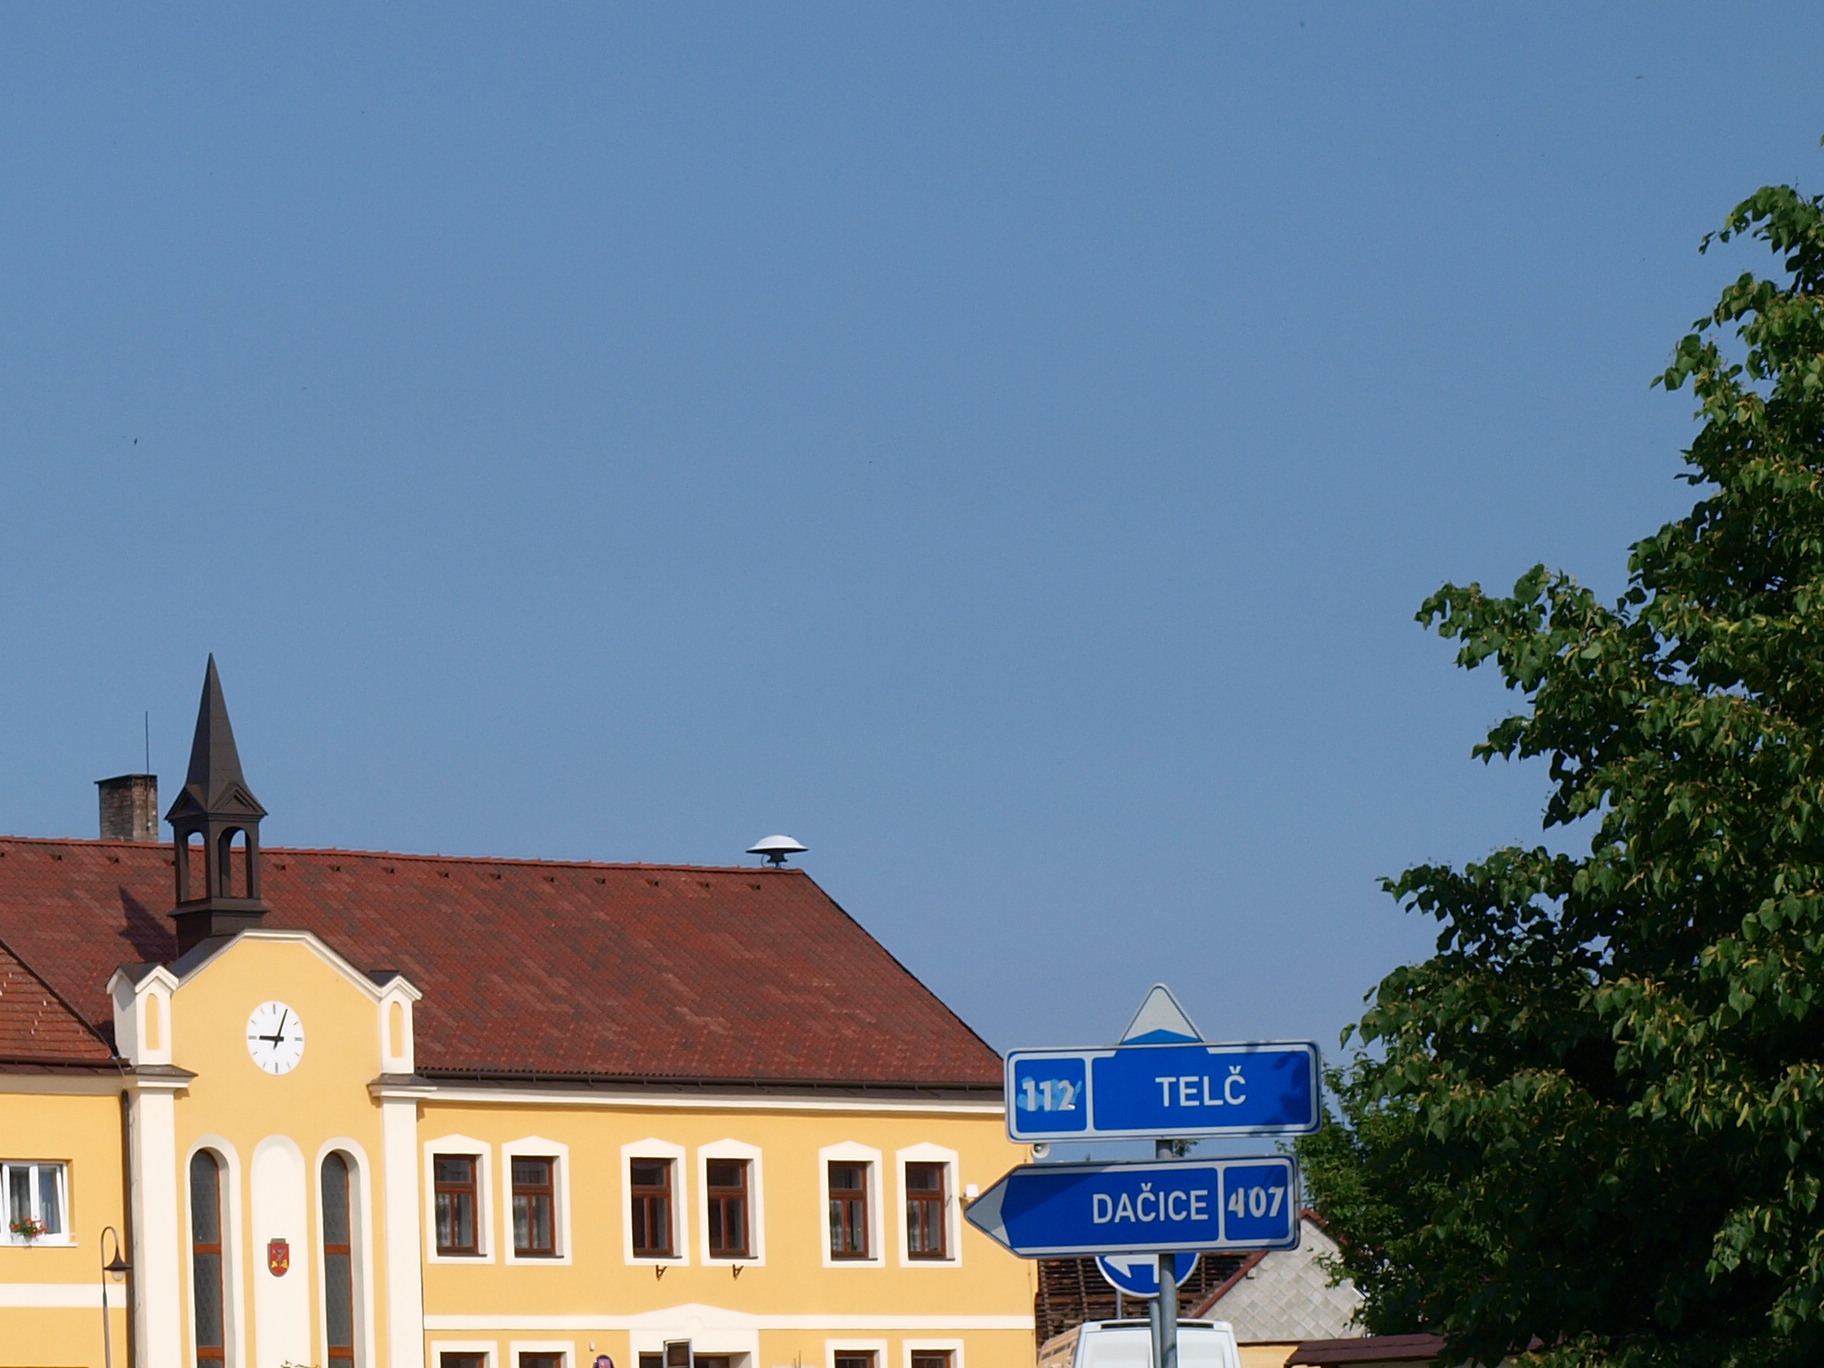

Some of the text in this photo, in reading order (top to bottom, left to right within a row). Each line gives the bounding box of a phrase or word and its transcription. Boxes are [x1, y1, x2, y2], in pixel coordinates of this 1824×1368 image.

[1022, 1079, 1076, 1112] 112
[1155, 1065, 1246, 1107] TELČ
[1092, 1182, 1209, 1224] DAČICE
[1228, 1186, 1285, 1218] 407
